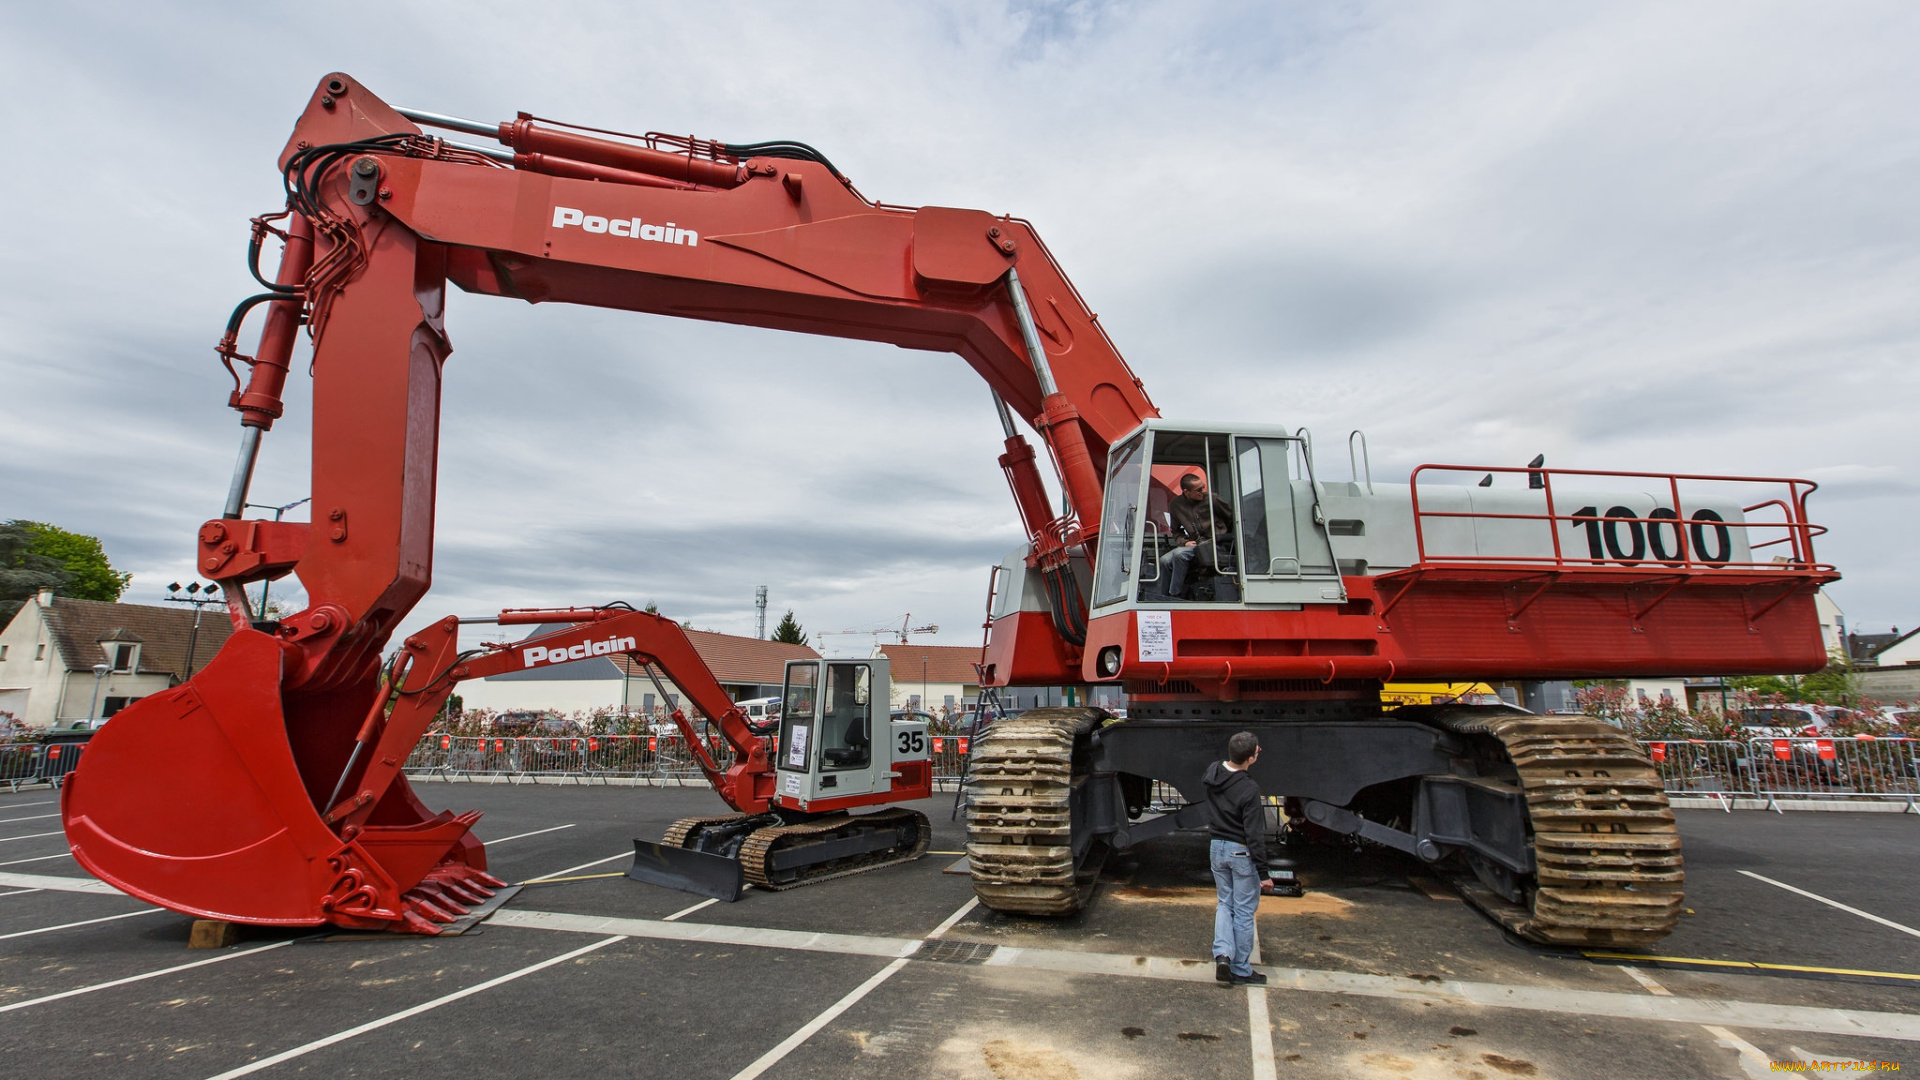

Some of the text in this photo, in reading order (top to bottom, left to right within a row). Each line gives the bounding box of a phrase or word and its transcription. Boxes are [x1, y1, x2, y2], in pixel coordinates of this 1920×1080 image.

[552, 206, 698, 247] Poclain
[1571, 506, 1731, 569] 1000
[523, 635, 636, 668] Poclain
[898, 731, 923, 754] 35
